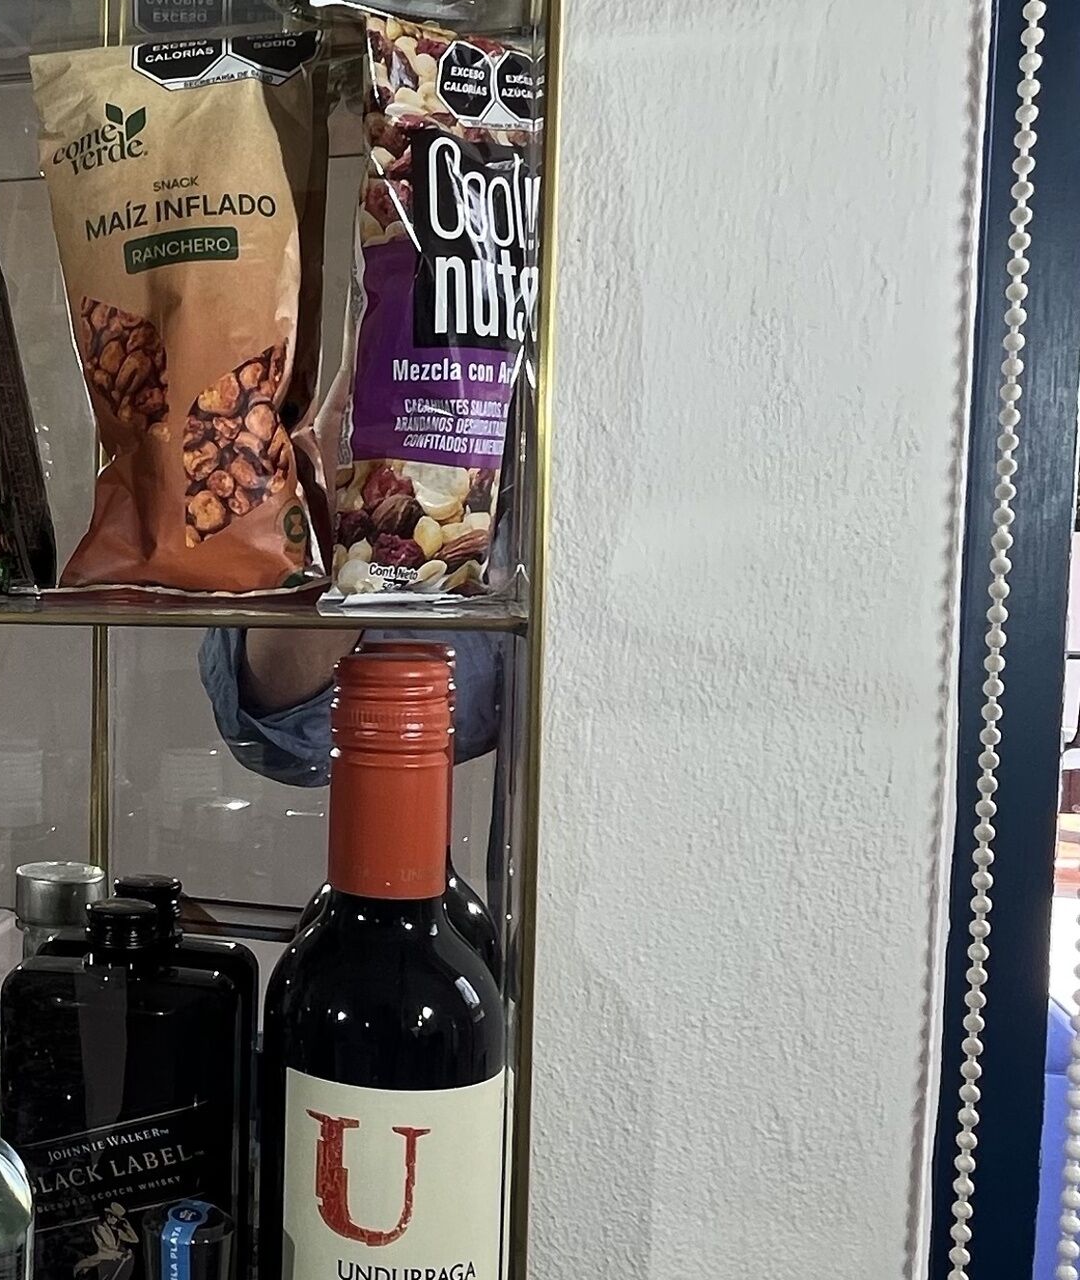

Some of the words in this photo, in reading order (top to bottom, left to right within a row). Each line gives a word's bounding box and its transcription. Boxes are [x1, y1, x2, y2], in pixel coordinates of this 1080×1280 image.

[144, 46, 214, 63] CALORÍAS
[450, 66, 485, 81] EXCESO
[52, 123, 118, 165] come
[153, 176, 199, 192] SNACK
[85, 201, 148, 242] MAÍZ
[155, 193, 277, 223] INFLADO
[131, 237, 231, 265] RANCHERO
[393, 357, 462, 381] Mezcla
[468, 364, 494, 382] con
[403, 433, 468, 454] CONFITADOS
[398, 567, 419, 580] Neto
[47, 1141, 106, 1164] JOHNNIE
[109, 1144, 193, 1178] LABEL
[90, 1185, 133, 1202] SCOTCH
[138, 1175, 182, 1191] WHISKY
[306, 1108, 432, 1247] U
[169, 1226, 182, 1260] PLATA
